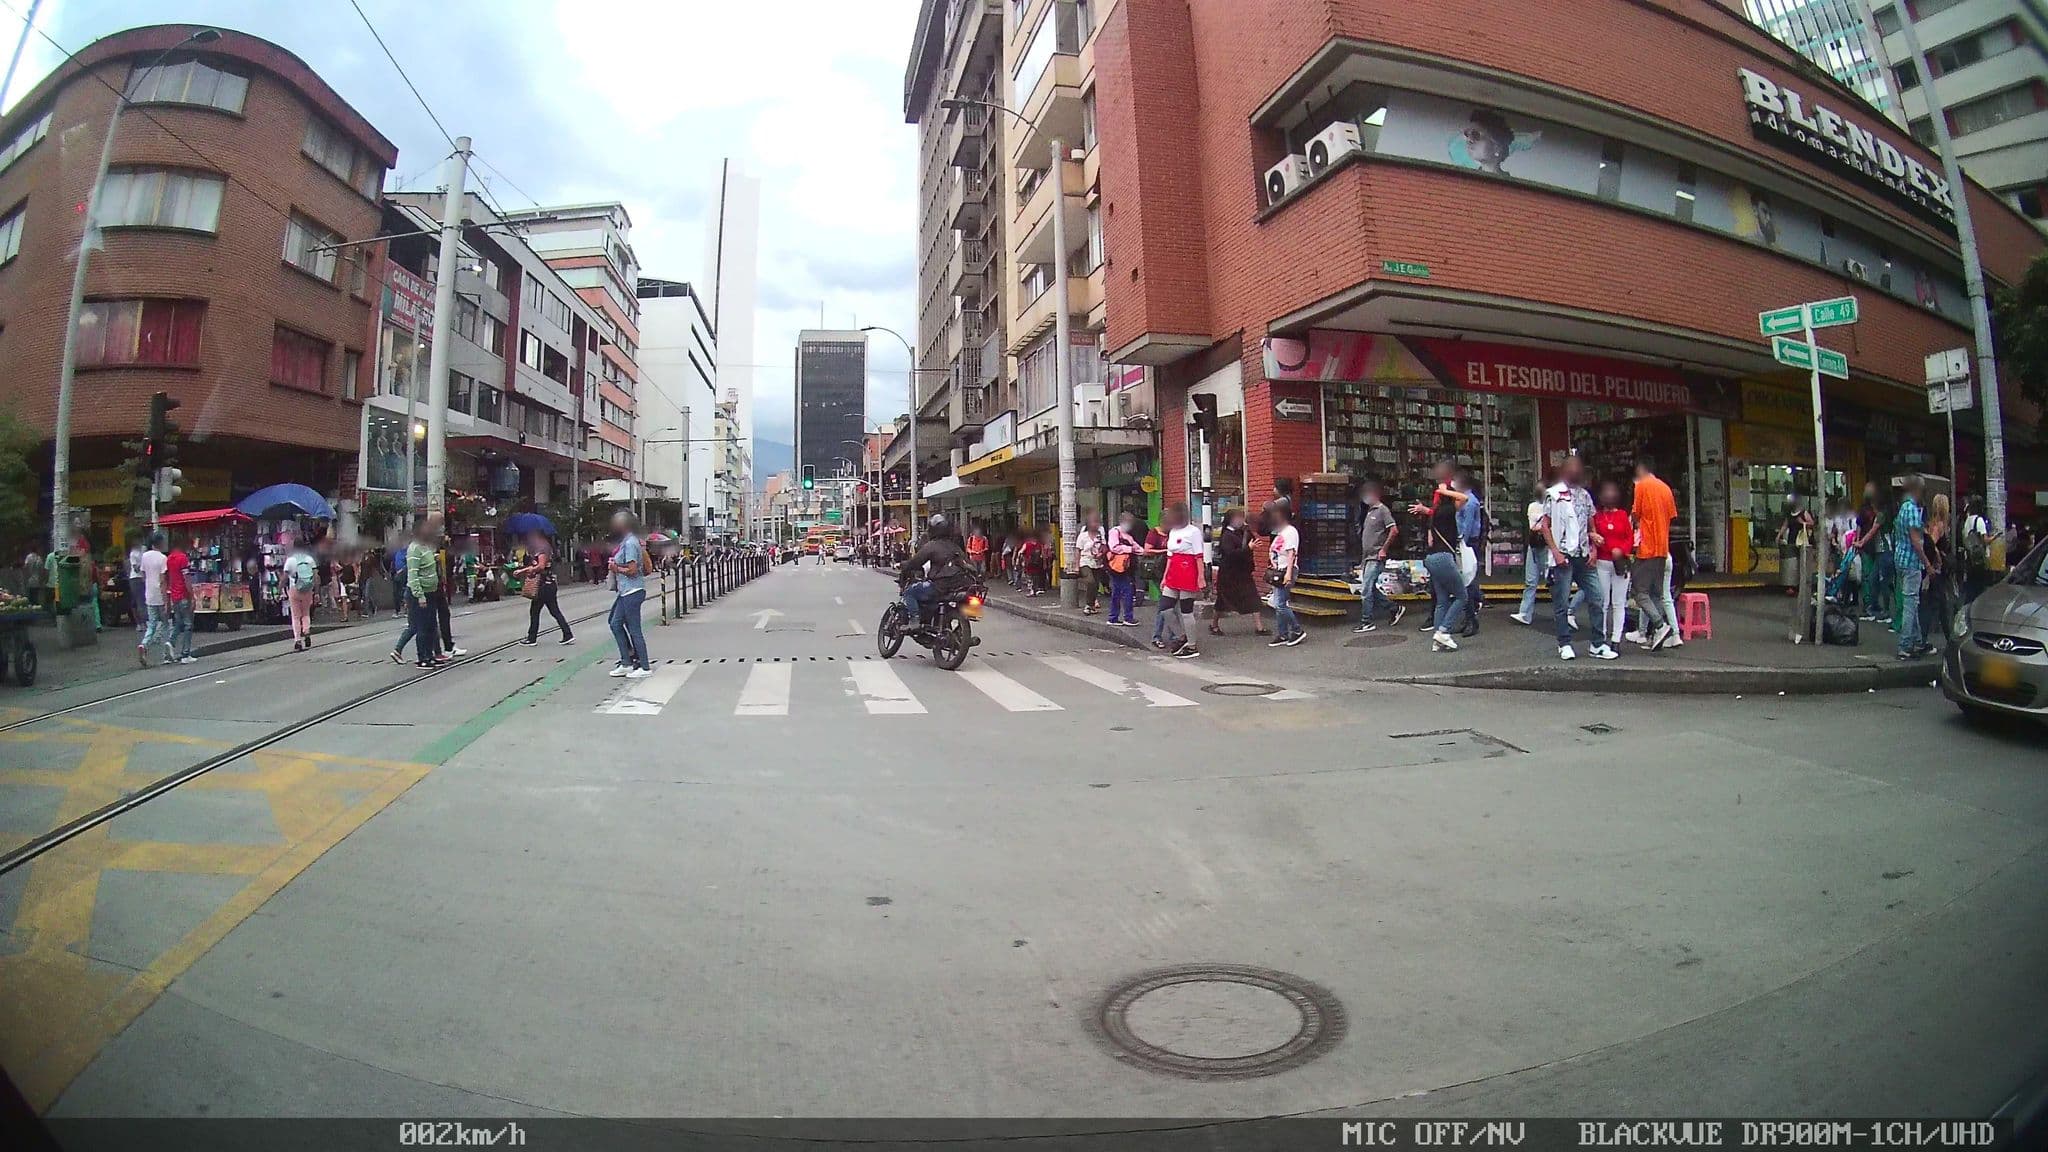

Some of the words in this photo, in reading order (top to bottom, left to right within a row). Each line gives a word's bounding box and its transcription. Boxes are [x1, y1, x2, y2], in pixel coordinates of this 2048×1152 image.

[1737, 67, 1954, 210] BLENDEX
[393, 270, 410, 290] CASA
[1814, 306, 1835, 322] Calle
[1839, 303, 1850, 318] 49
[1467, 361, 1491, 386] EL
[1494, 363, 1566, 392] TESORO
[1570, 371, 1601, 396] DEL
[1605, 376, 1690, 405] PELUQUERO
